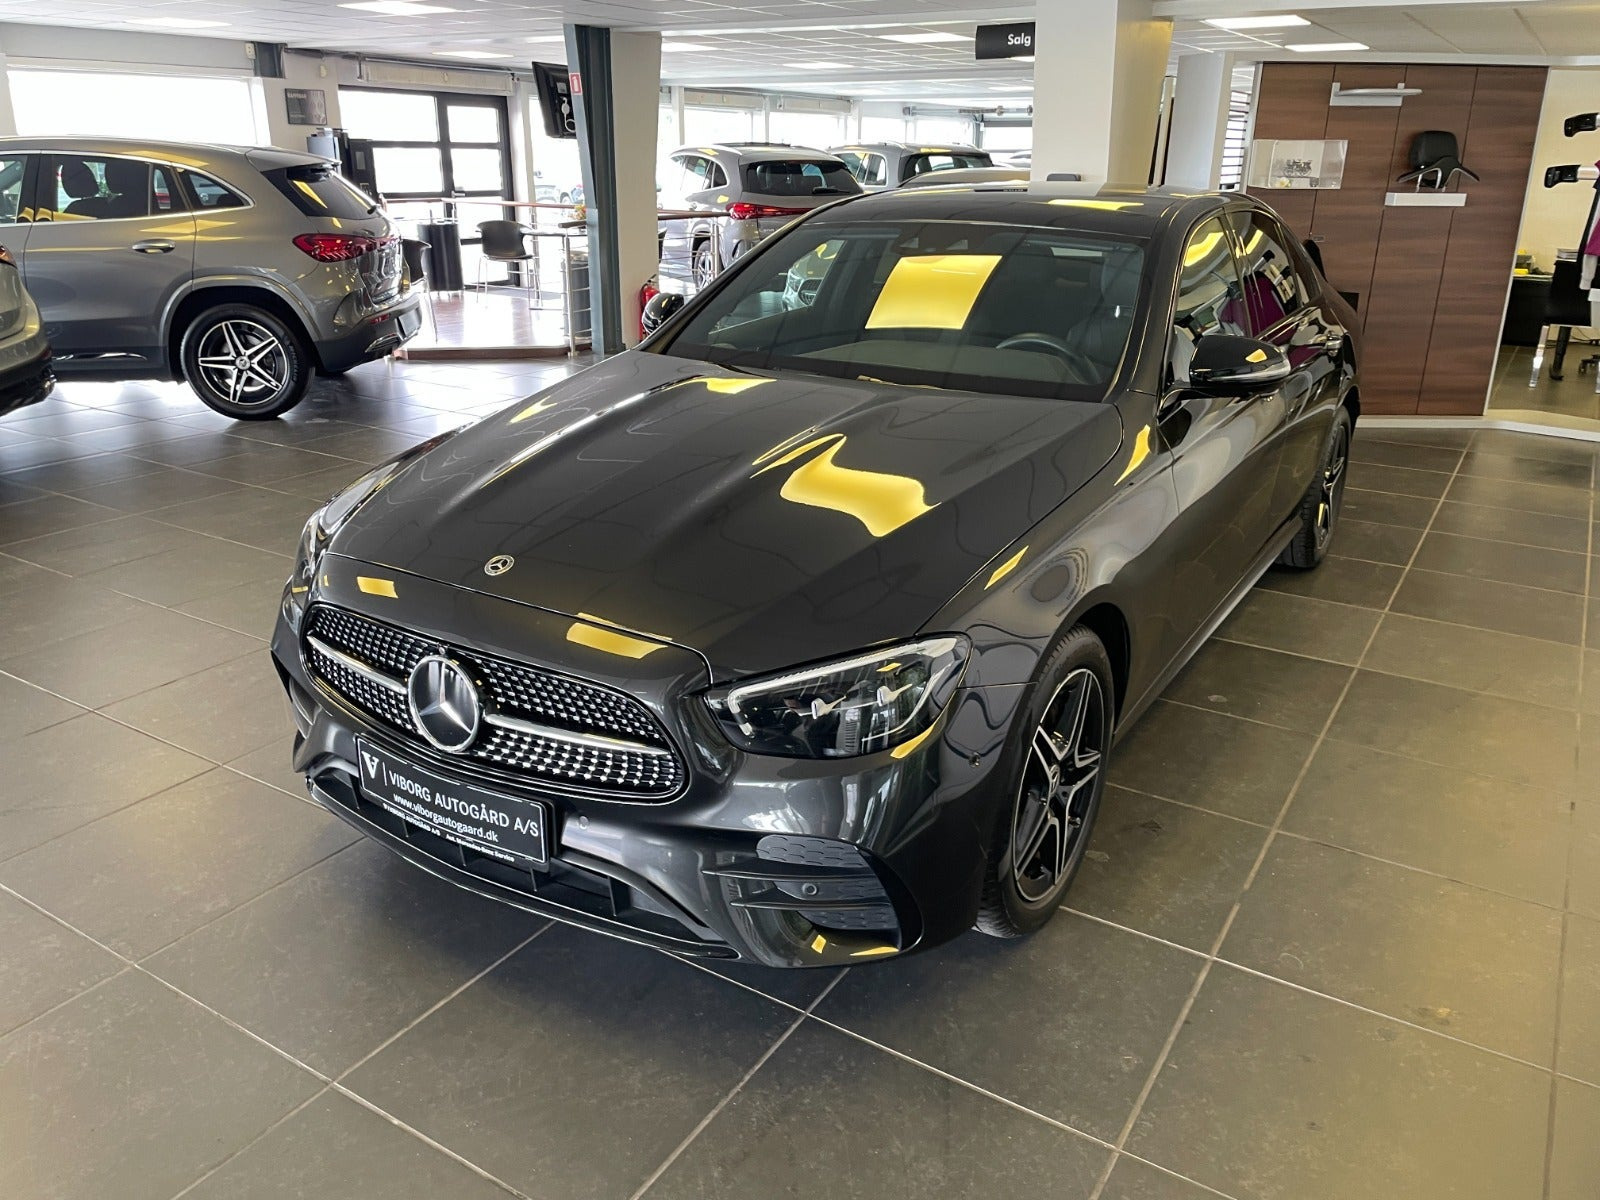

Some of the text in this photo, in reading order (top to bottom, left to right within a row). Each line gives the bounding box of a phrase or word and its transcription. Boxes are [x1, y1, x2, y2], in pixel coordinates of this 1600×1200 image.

[1007, 32, 1031, 47] Salg
[388, 769, 539, 837] VIBORG AUTOGÅRD A/S
[393, 793, 498, 842] www.viborgautogaard.dk
